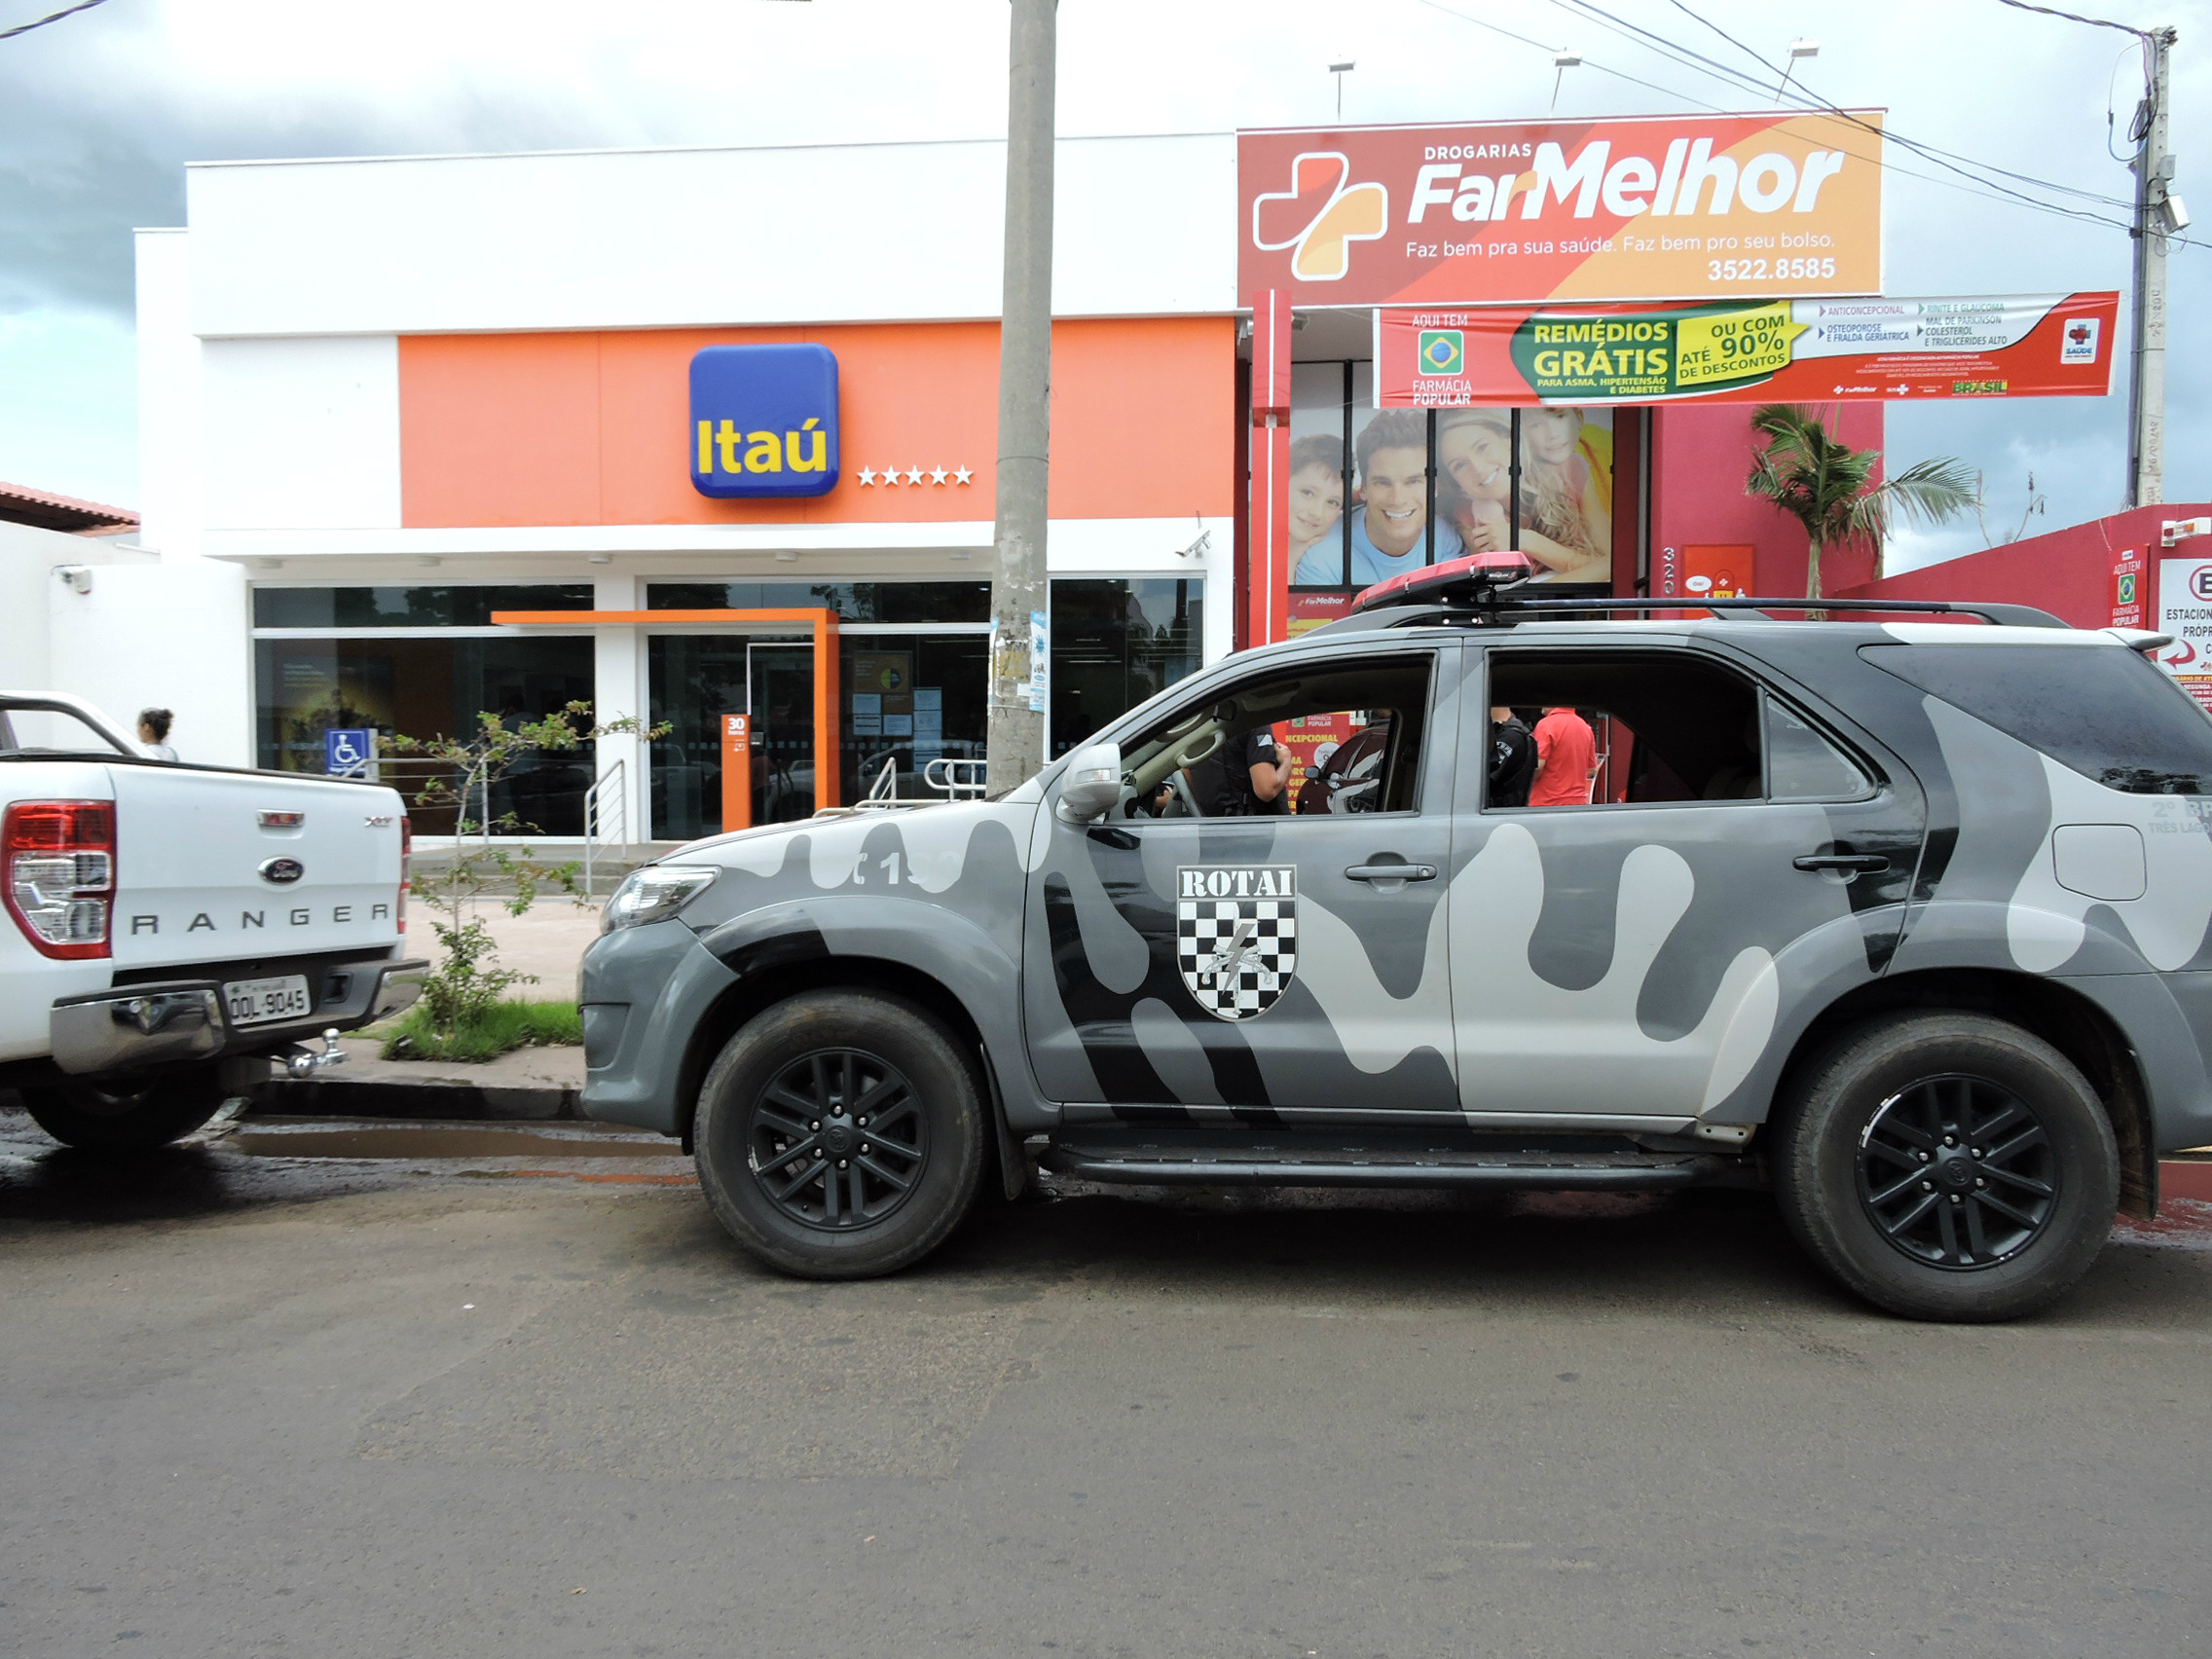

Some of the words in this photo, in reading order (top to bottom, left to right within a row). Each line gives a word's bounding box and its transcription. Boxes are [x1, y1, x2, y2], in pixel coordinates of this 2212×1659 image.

[1424, 143, 1531, 161] DROGARIAS
[1407, 137, 1846, 223] FarMelhor
[1406, 241, 1438, 258] Faz
[1443, 240, 1485, 257] bem
[1488, 242, 1519, 260] pra
[1524, 241, 1555, 255] sua
[1560, 235, 1618, 254] saúde.
[1624, 235, 1655, 253] Faz
[1661, 232, 1701, 251] bem
[1707, 237, 1738, 254] pro
[1744, 235, 1776, 249] seu
[1781, 231, 1835, 248] bolso.
[1708, 257, 1835, 280] 3522.8585
[1828, 306, 1905, 315] ANTICONCEPCIONAL
[1927, 304, 1952, 313] RINITE
[1953, 304, 1958, 313] E
[1960, 303, 2006, 313] GLAUCOMA
[1412, 314, 1439, 328] AQUI
[1443, 313, 1468, 327] TEM
[1711, 324, 1736, 339] OU
[1742, 314, 1785, 335] COM
[1926, 316, 1943, 326] MAL
[1945, 316, 1956, 325] DE
[1958, 315, 2002, 324] PARKINSON
[1533, 318, 1668, 345] REMÉDIOS
[1826, 323, 1882, 334] OSTEOPOROSE
[1925, 326, 1972, 337] COLESTEROL
[1833, 333, 1863, 342] FRALDA
[1864, 330, 1910, 341] GERIÁTRICA
[1925, 338, 1930, 347] E
[1989, 335, 2009, 345] ALTO
[1681, 346, 1712, 365] ATÉ
[1720, 329, 1785, 358] 90%
[1533, 344, 1668, 377] GRÁTIS
[1679, 367, 1696, 380] DE
[1699, 352, 1785, 377] DESCONTOS
[1413, 378, 1472, 392] FARMÁCIA
[1537, 379, 1563, 387] PARA
[1565, 379, 1598, 388] ASMA,
[1600, 375, 1667, 387] HIPERTENSÃO
[1953, 381, 2008, 393] BRASIL
[1618, 386, 1666, 394] DIABETES
[1413, 392, 1471, 406] POPULAR
[697, 418, 827, 474] Itaú
[2113, 563, 2128, 575] AQUI
[2128, 560, 2141, 572] TEM
[2113, 615, 2139, 627] POPULAR
[2166, 608, 2212, 620] ESTACION
[2183, 623, 2212, 638] PRÓPR
[728, 718, 746, 730] 30
[1181, 869, 1293, 898] ROTAI
[131, 903, 388, 935] RANGER
